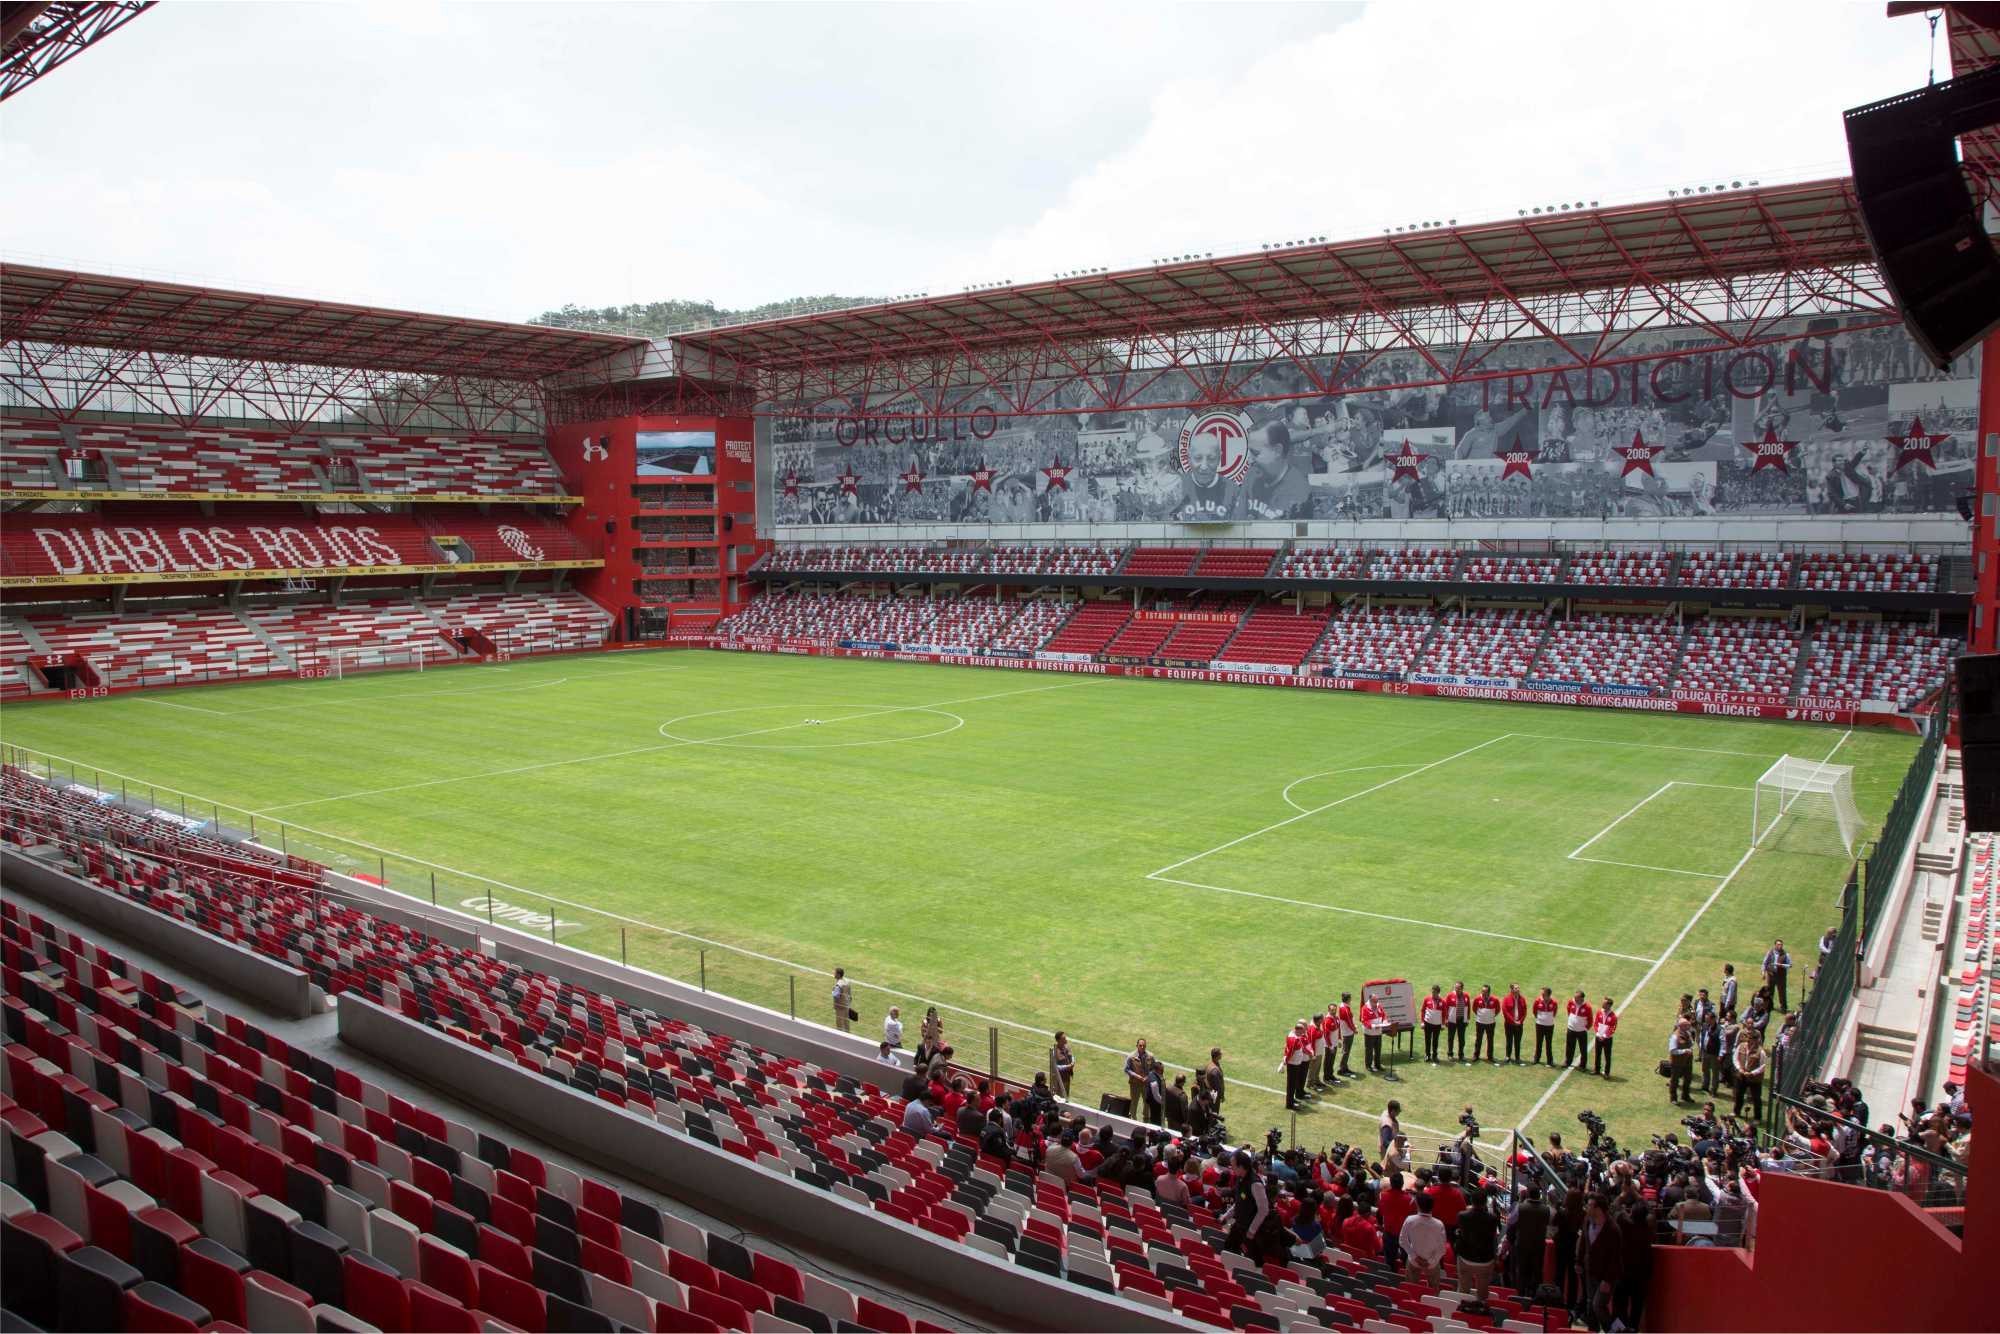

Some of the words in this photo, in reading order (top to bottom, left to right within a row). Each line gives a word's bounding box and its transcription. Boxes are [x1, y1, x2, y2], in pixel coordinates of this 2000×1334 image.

[1474, 347, 1834, 413] TRADICION
[835, 404, 998, 446] ORGULLO
[1757, 443, 1784, 456] 2008
[1903, 436, 1931, 451] 2010
[1506, 453, 1529, 464] 2002
[1625, 447, 1651, 460] 2005
[1397, 456, 1417, 468] 2000
[1050, 468, 1064, 479] 1999
[32, 527, 256, 576] DIABLOS
[247, 526, 402, 569] ROJOS
[940, 655, 954, 665] QUE
[957, 656, 967, 665] EL
[998, 658, 1024, 669] RUEDE
[1036, 661, 1075, 673] NUESTRO
[1078, 664, 1106, 674] FAVOR
[1167, 669, 1204, 681] EQUIPO
[1209, 672, 1222, 682] DE
[1227, 673, 1275, 685] ORGULLO
[71, 689, 87, 699] E9
[92, 687, 109, 697] E9
[1394, 683, 1409, 695] E2
[1528, 681, 1582, 694] citibanamex
[1592, 685, 1649, 698] citibanamex
[1436, 686, 1509, 700] SOMOSDIABLOS
[1511, 690, 1577, 705] SOMOSROJOS
[1580, 695, 1679, 711] SOMOSGANADORES
[1671, 689, 1711, 702] TOLUCA
[1714, 692, 1728, 703] FC
[1703, 702, 1745, 717] TOLUCA
[1746, 706, 1761, 718] FC
[1799, 697, 1841, 710] TOLUCA
[1845, 700, 1861, 711] FC
